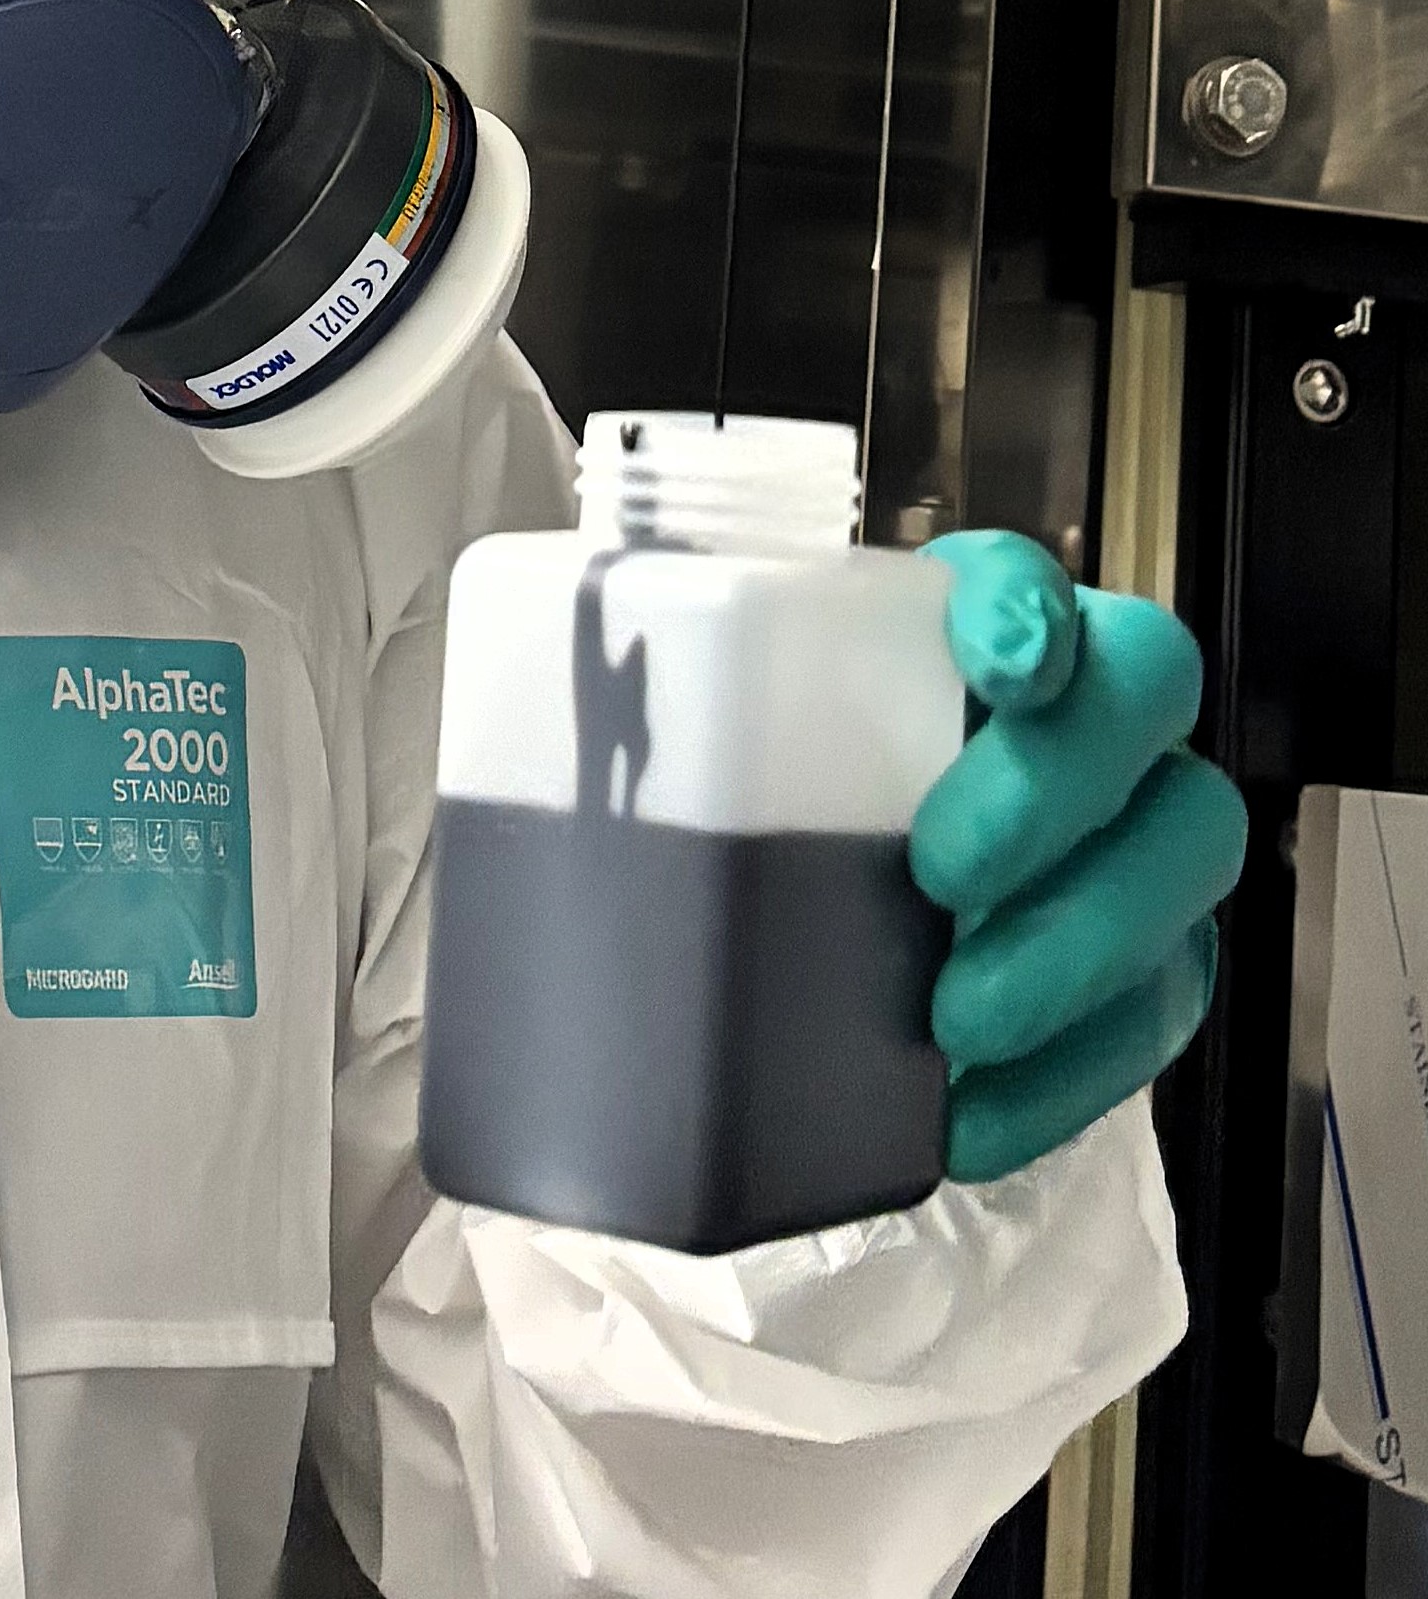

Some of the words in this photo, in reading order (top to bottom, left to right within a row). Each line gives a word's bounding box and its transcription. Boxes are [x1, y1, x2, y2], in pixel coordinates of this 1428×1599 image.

[308, 294, 360, 343] 0121
[208, 349, 297, 399] MOLDEX
[51, 667, 227, 719] AlphaTec
[122, 727, 229, 776] 2000
[112, 778, 231, 807] STANDARD
